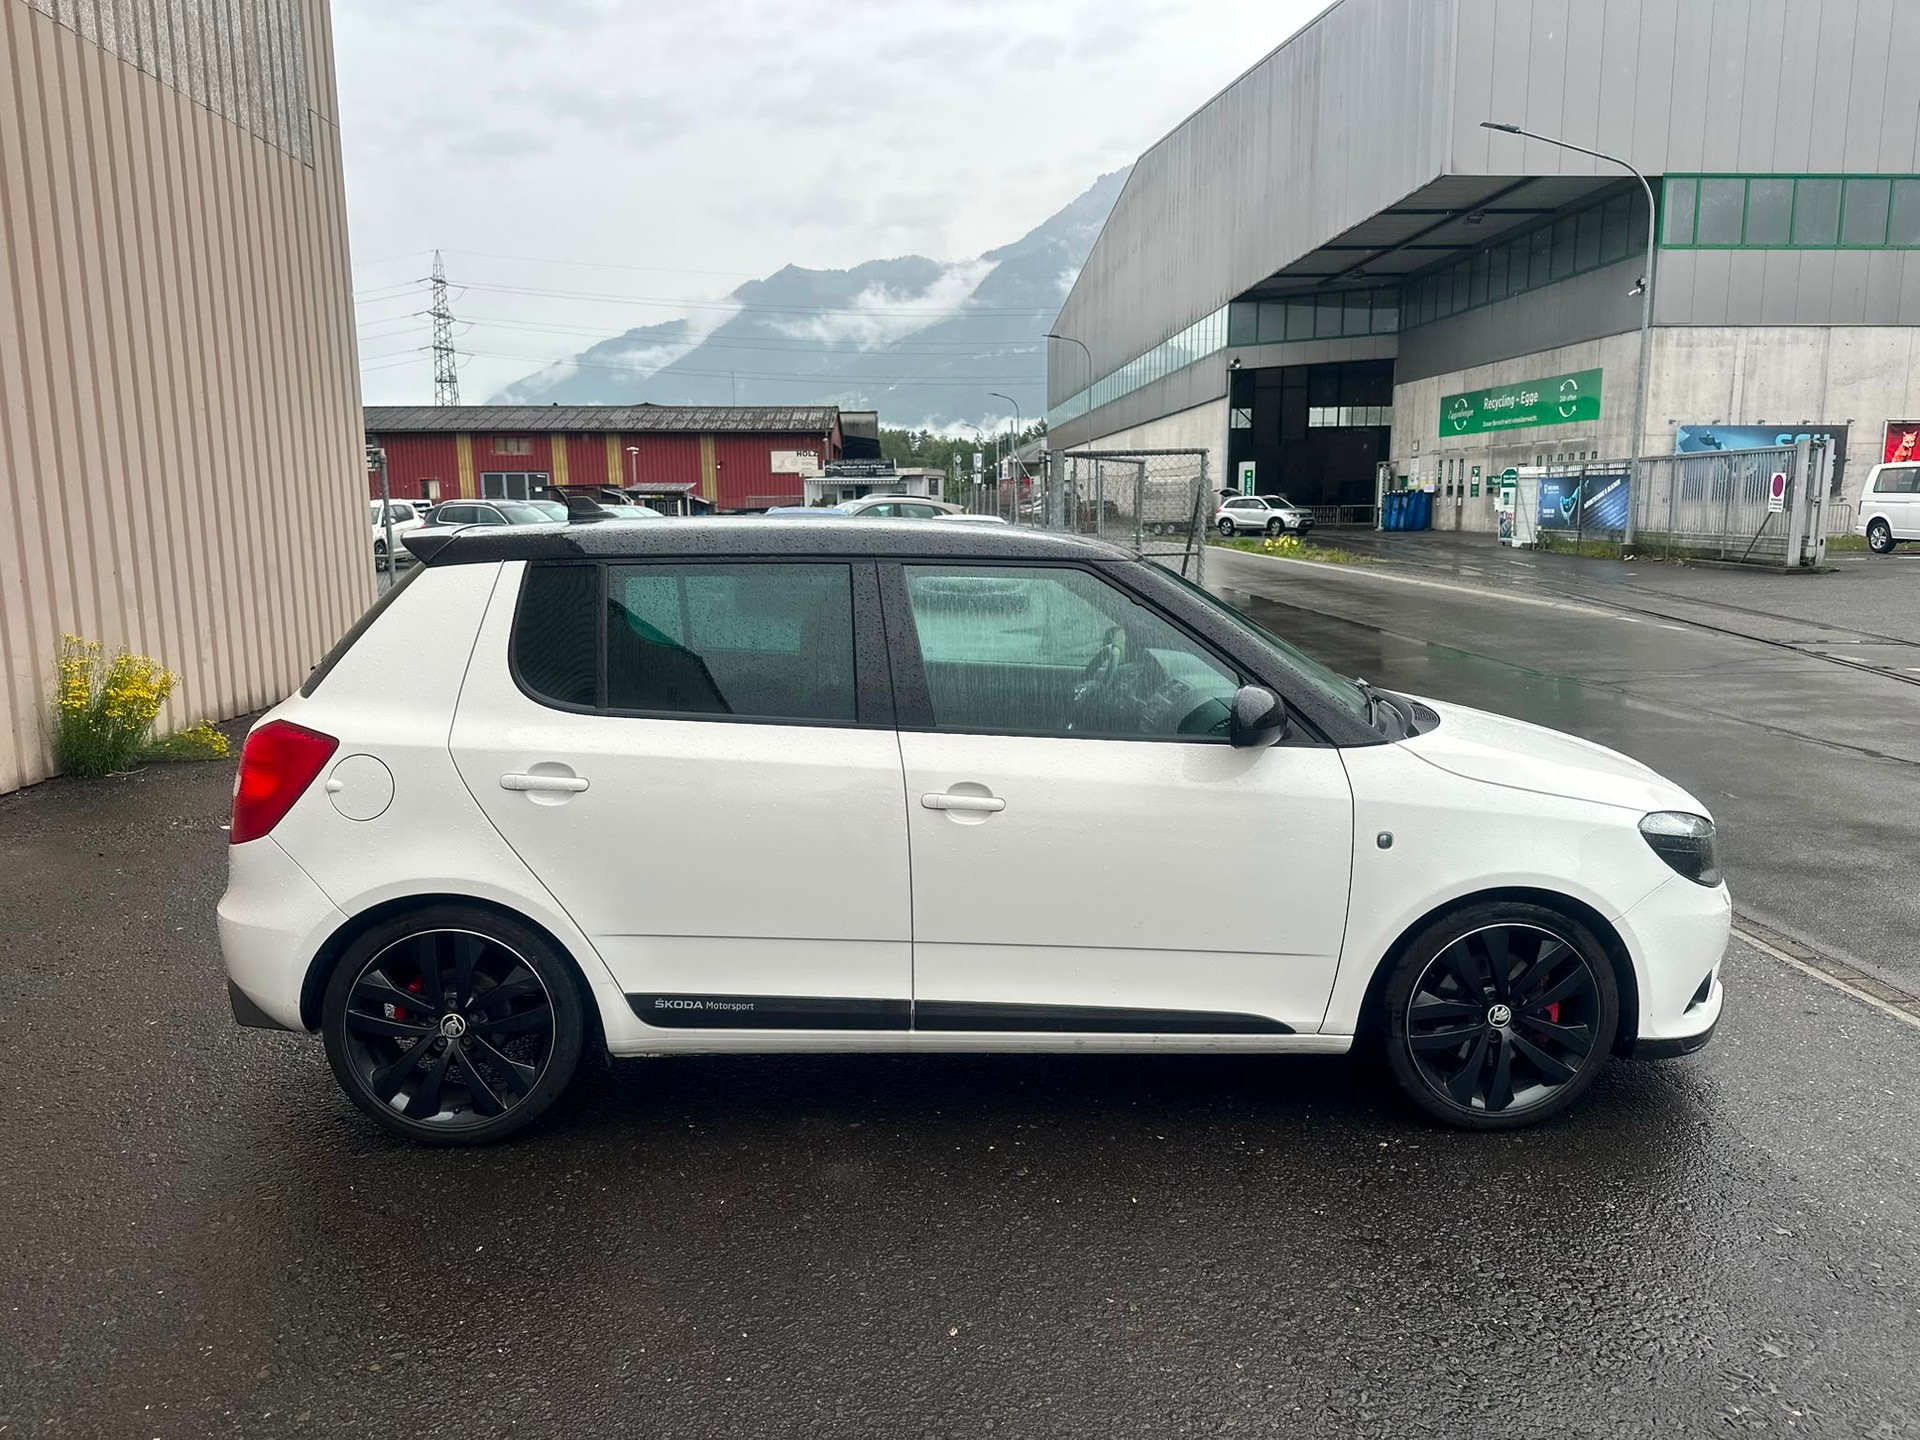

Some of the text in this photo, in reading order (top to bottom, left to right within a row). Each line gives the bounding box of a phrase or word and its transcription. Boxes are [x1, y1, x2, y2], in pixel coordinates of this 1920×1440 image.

[1483, 394, 1515, 411] Recycling
[1520, 391, 1539, 406] Egge
[654, 997, 755, 1011] ŠKODA Motorsport
